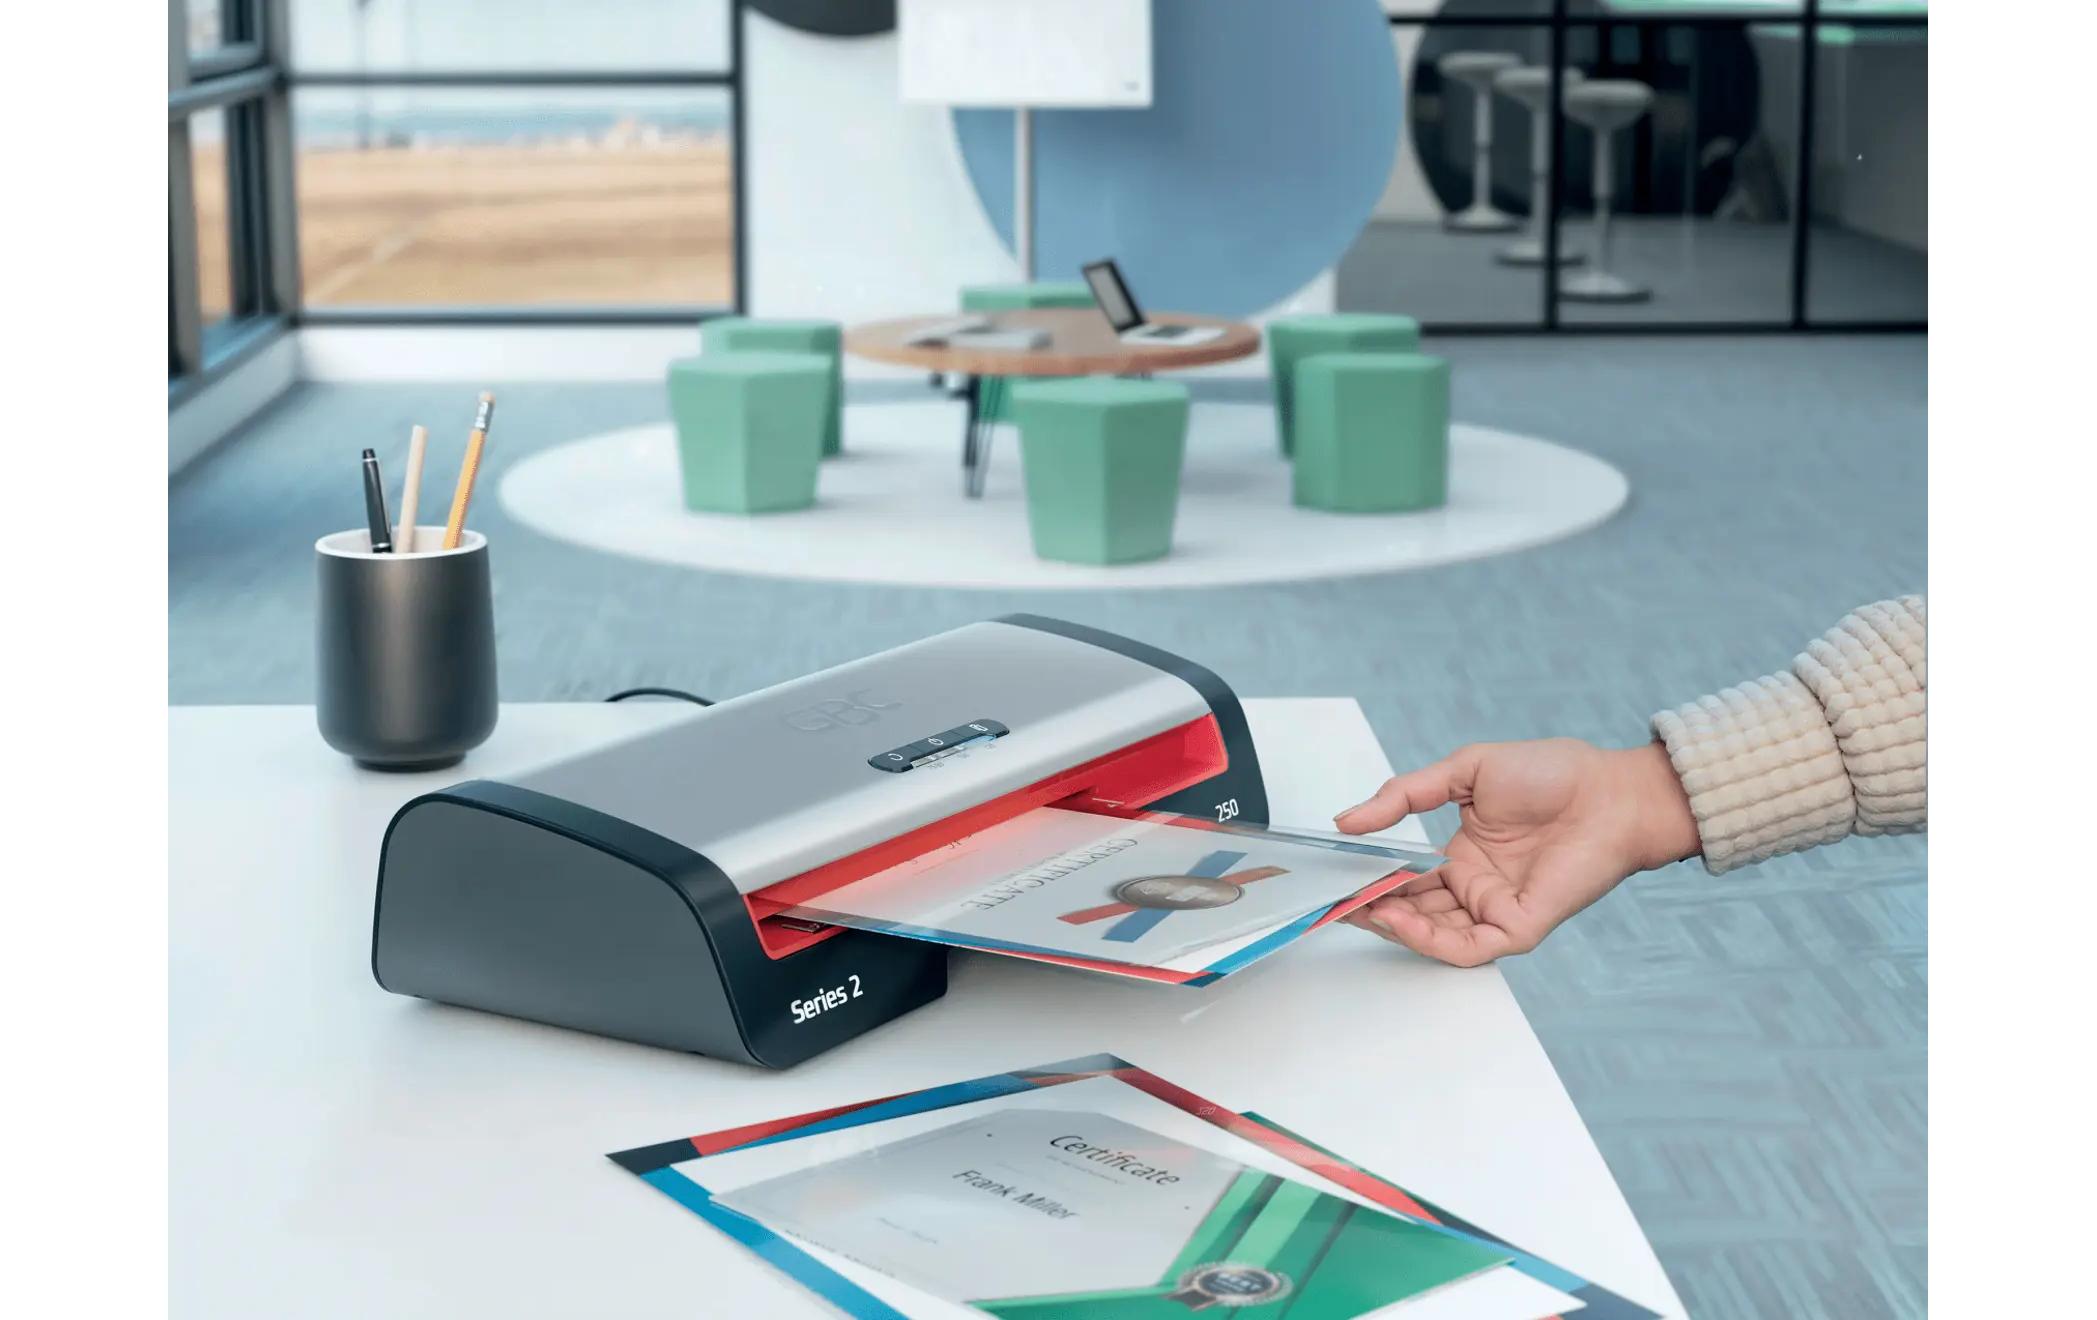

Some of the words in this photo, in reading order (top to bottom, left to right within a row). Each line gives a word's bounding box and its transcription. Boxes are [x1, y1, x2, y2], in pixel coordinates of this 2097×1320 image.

[1215, 798, 1240, 823] 250
[790, 987, 848, 1024] Series
[848, 974, 864, 999] 2
[1049, 1134, 1180, 1186] Certificate
[952, 1169, 1017, 1198] Frank
[1012, 1192, 1079, 1220] Miller
